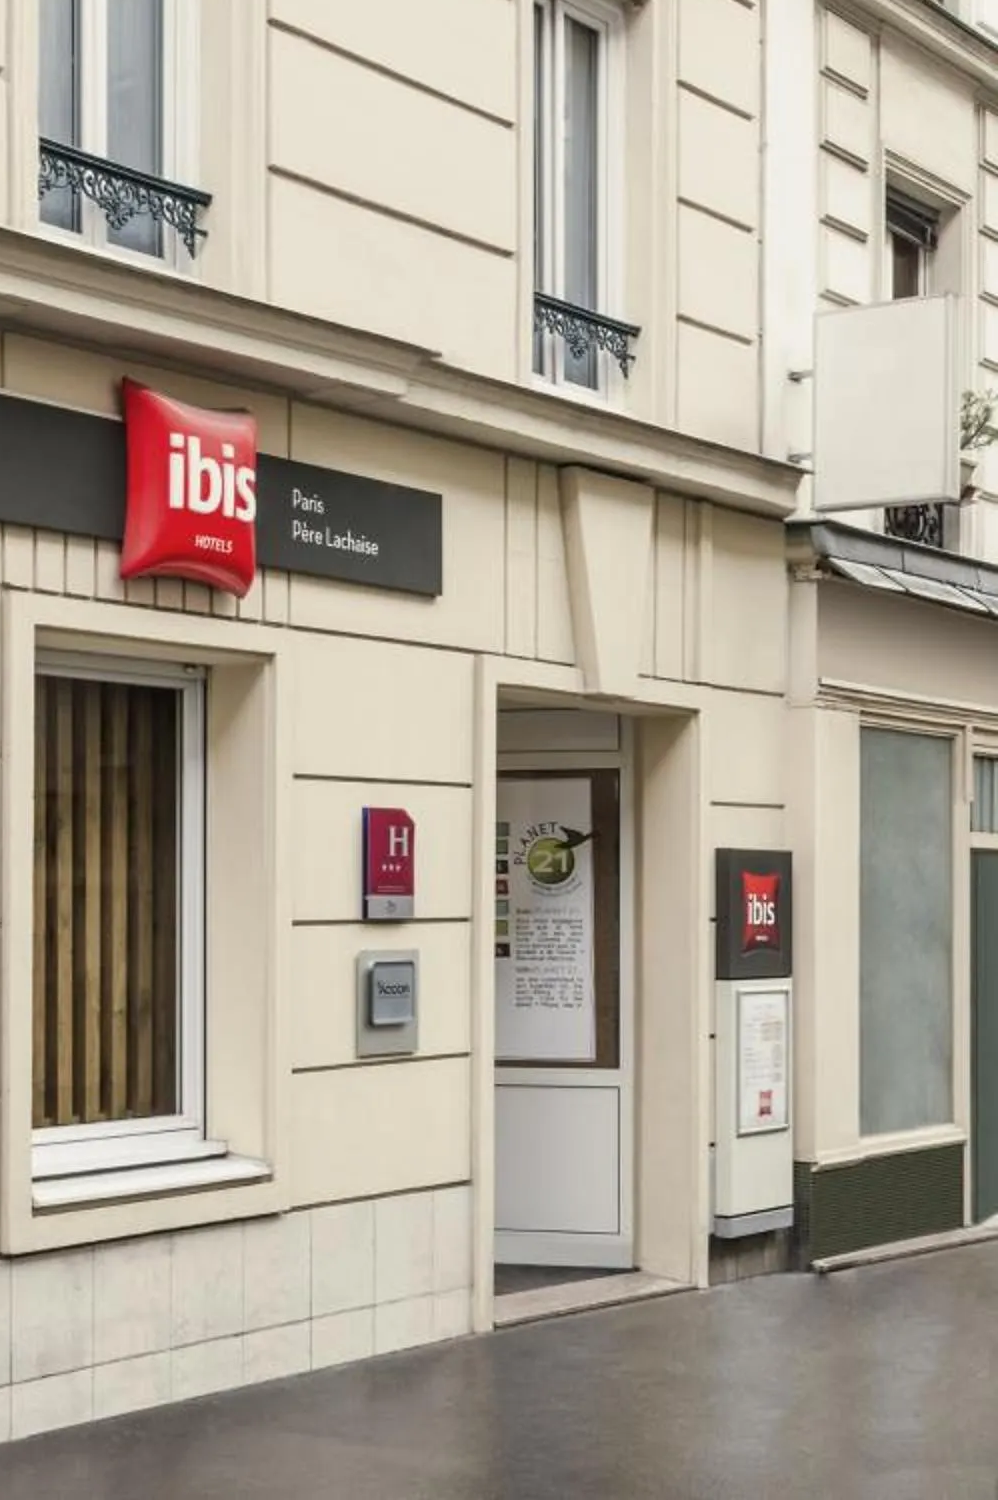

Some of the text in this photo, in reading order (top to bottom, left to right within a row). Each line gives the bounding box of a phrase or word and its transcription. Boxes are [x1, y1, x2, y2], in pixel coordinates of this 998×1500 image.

[169, 432, 256, 523] ibis
[292, 488, 325, 514] Paris
[194, 534, 233, 554] HOTELS
[292, 519, 379, 555] Père Lachaise
[388, 825, 409, 857] H
[513, 821, 559, 865] PLANET
[532, 849, 568, 873] 21
[747, 892, 775, 926] ibis
